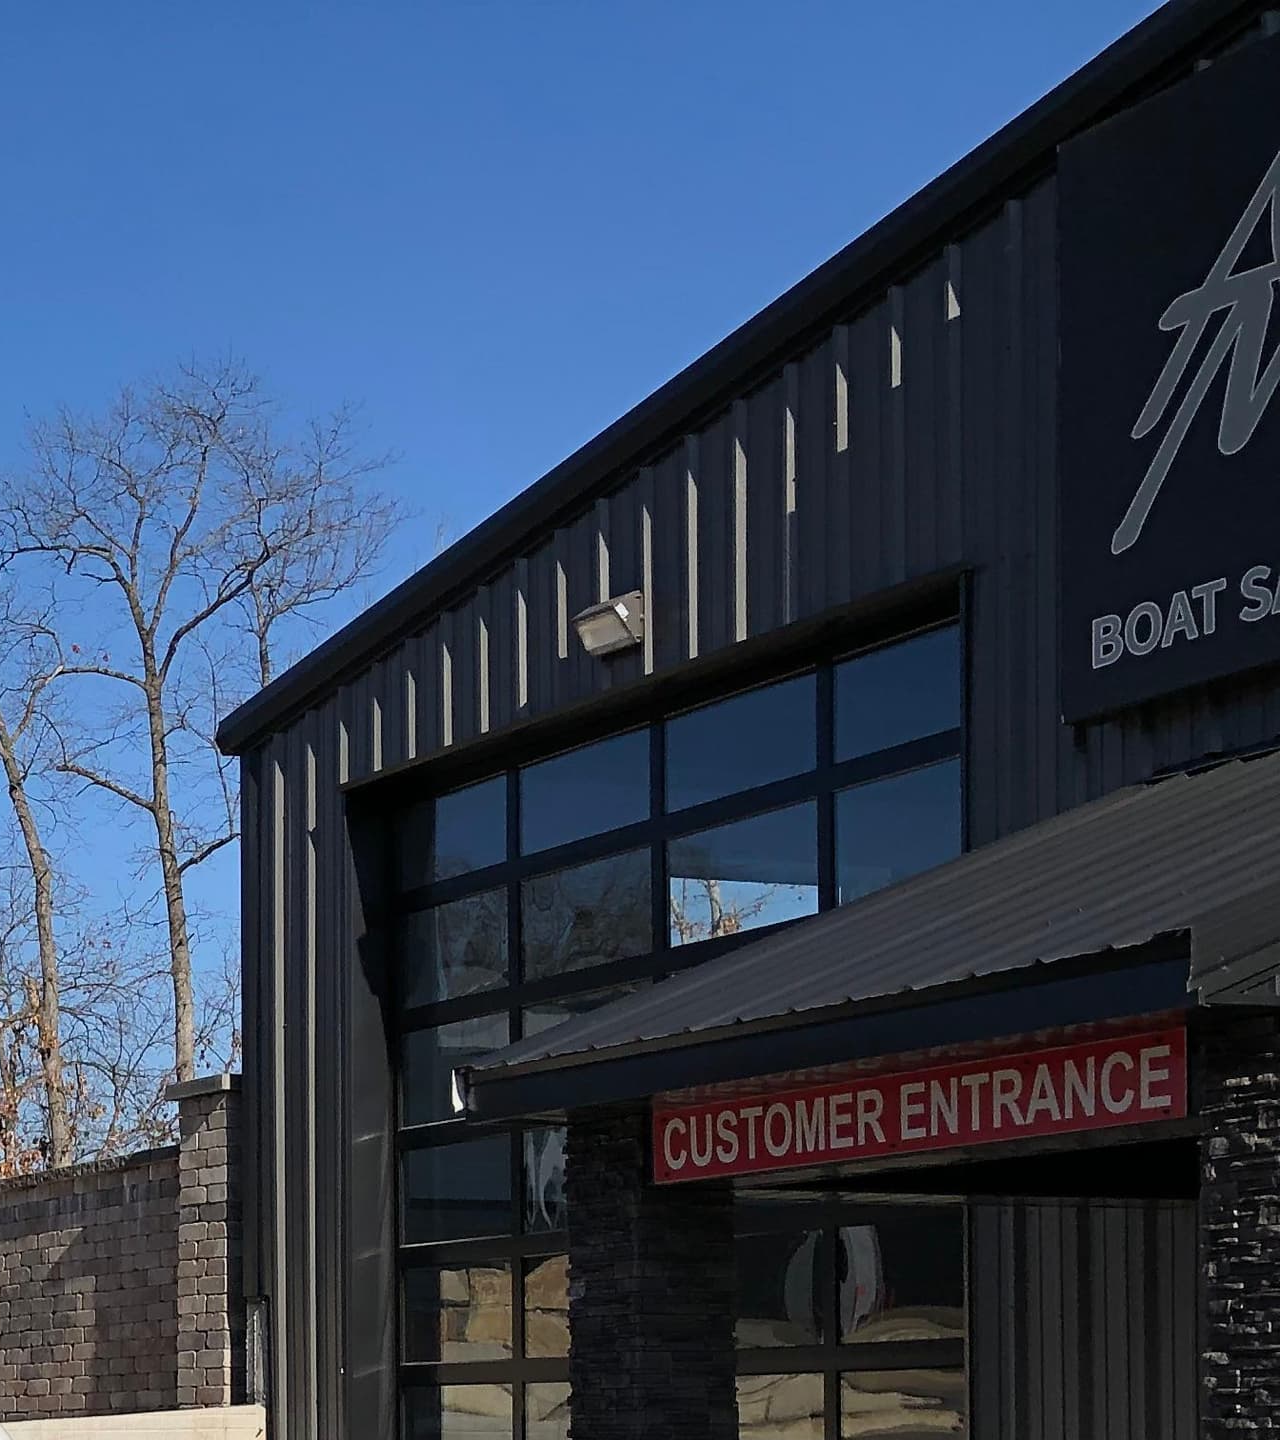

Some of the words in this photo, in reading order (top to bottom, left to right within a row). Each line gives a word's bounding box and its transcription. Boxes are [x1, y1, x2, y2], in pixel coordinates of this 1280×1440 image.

[1092, 577, 1228, 669] BOAT
[1239, 565, 1280, 622] S
[663, 1088, 887, 1171] CUSTOMER
[900, 1044, 1173, 1141] ENTRANCE
